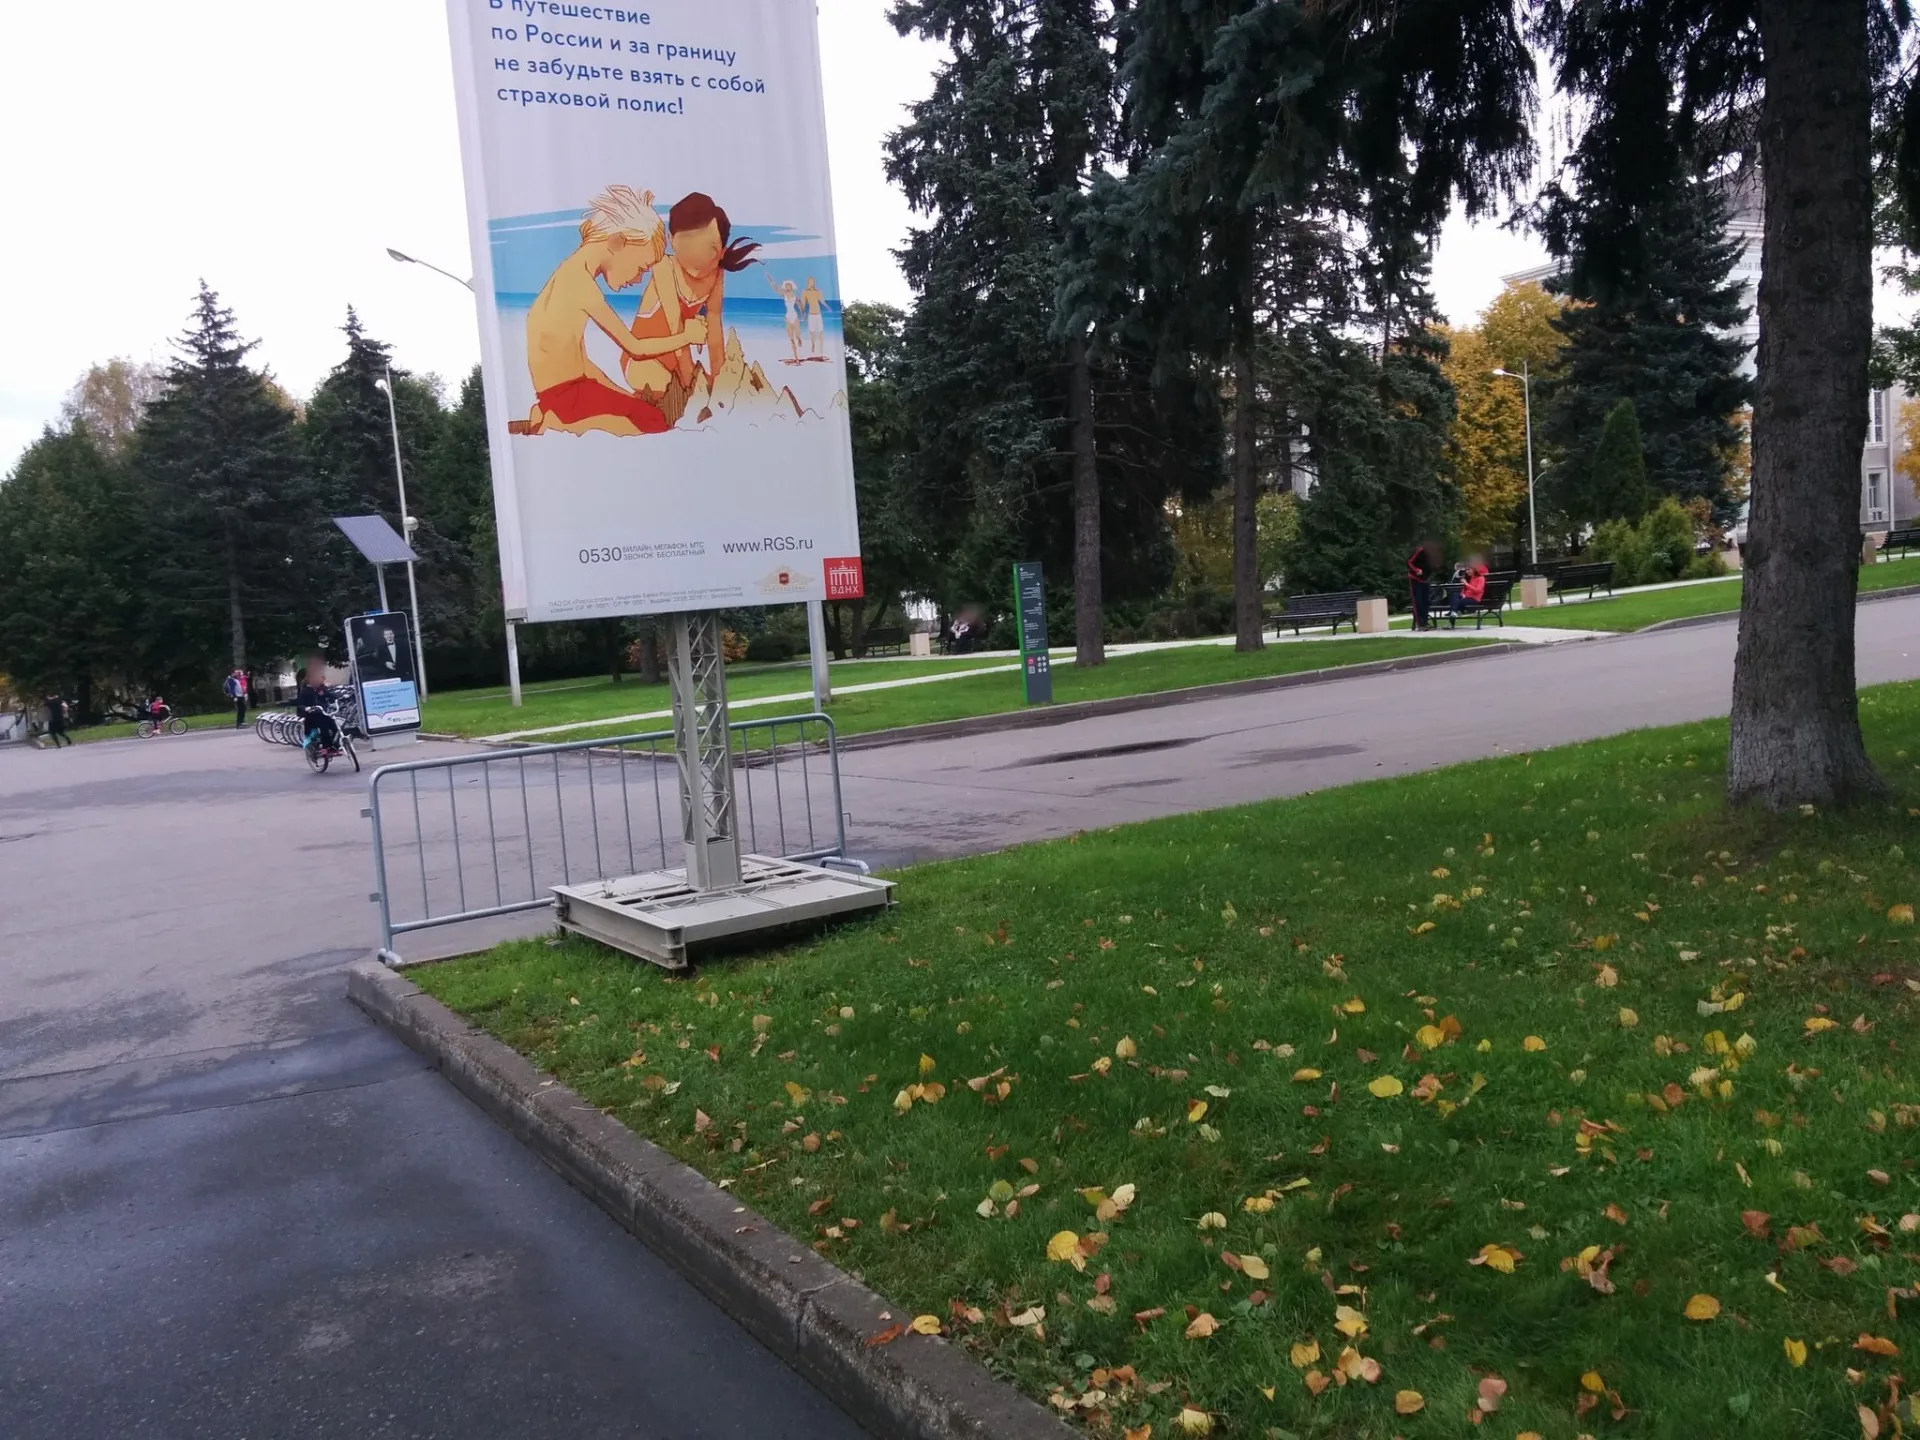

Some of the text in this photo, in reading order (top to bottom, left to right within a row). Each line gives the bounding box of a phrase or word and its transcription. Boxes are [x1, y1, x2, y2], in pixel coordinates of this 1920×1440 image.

[511, 0, 651, 25] путешествие
[491, 23, 736, 67] по России и за границу
[494, 57, 765, 94] не забудьте взять с собой
[496, 87, 684, 115] страховой полис!
[578, 547, 622, 564] 0530
[690, 541, 704, 549] МТС
[623, 548, 706, 561] ЗВОНОК БЕСПЛАТНЫЙ
[723, 536, 814, 554] www.RGS.ru
[830, 585, 860, 595] ВДНХ
